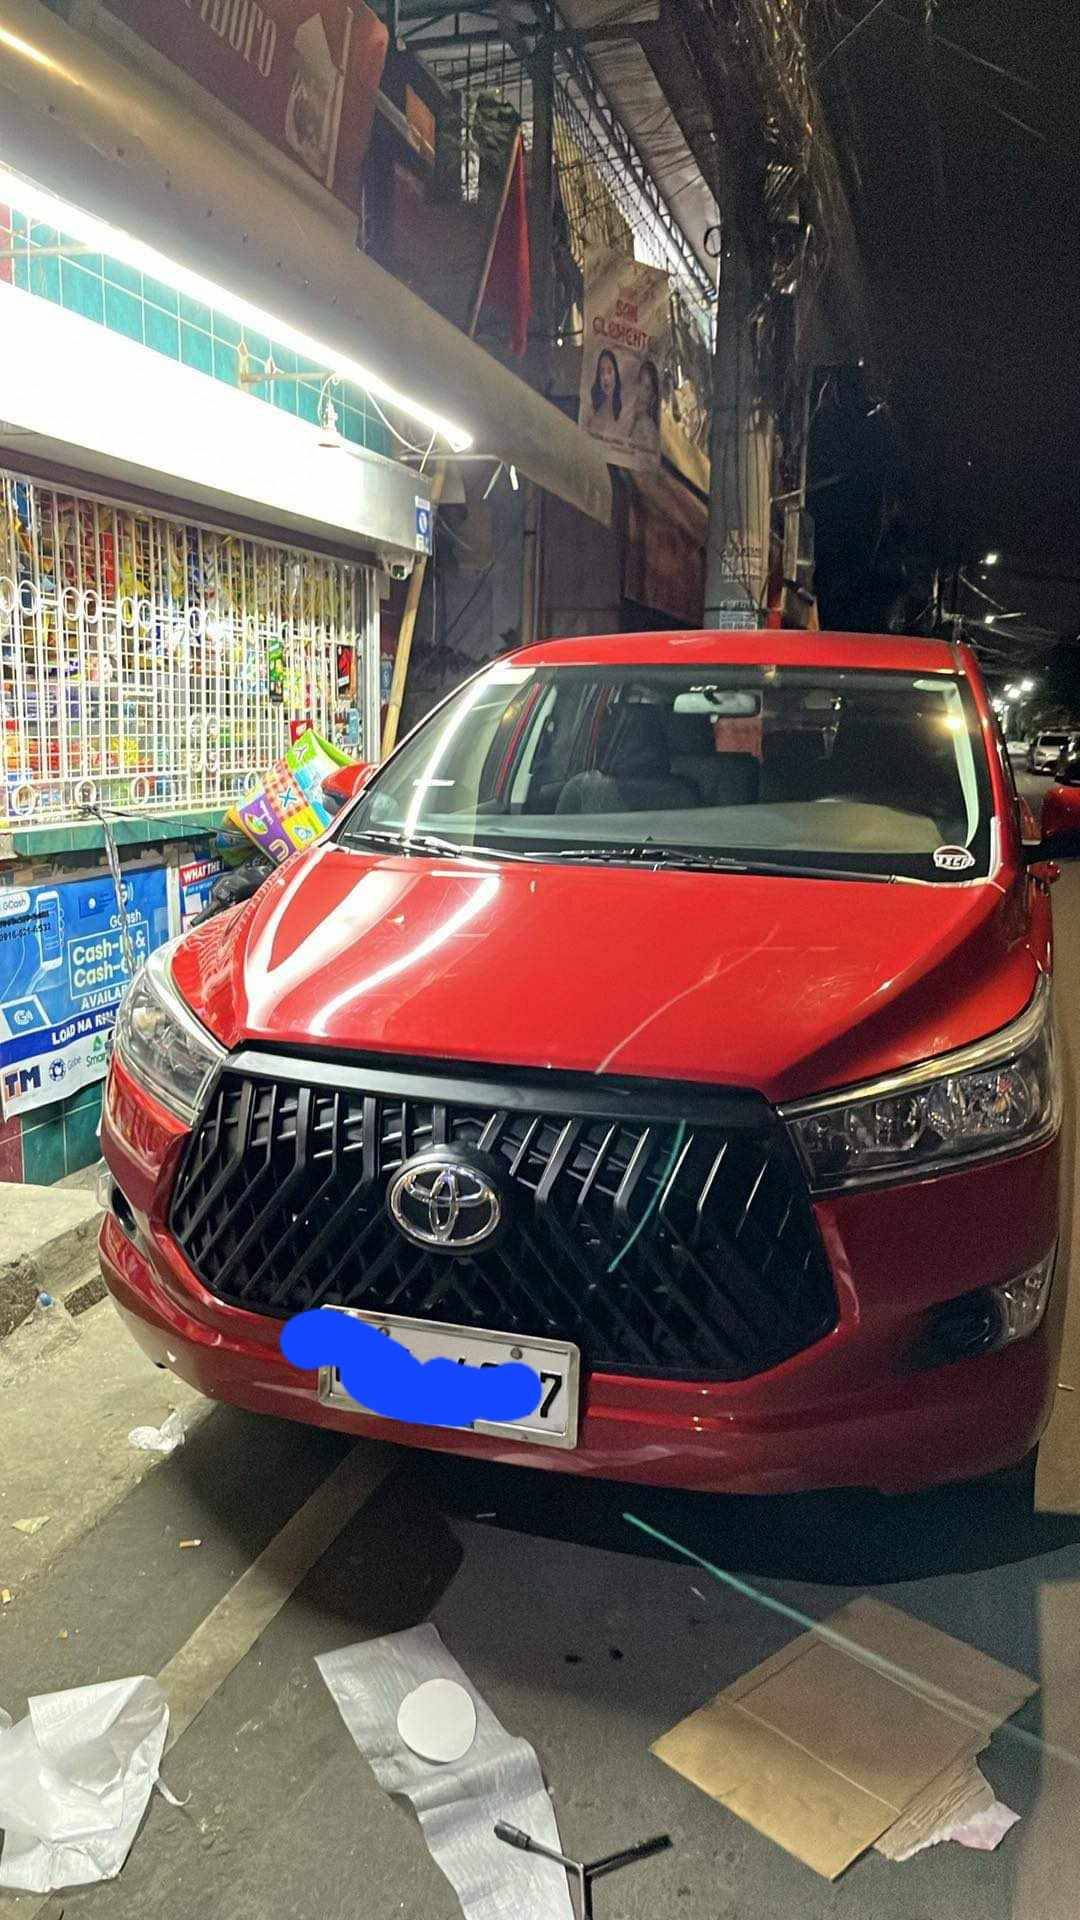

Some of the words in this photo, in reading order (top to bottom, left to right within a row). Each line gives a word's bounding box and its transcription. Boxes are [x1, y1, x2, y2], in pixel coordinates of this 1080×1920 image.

[135, 930, 146, 949] &
[51, 1024, 77, 1045] LOAD
[77, 1017, 93, 1034] NA
[5, 1064, 41, 1098] TM
